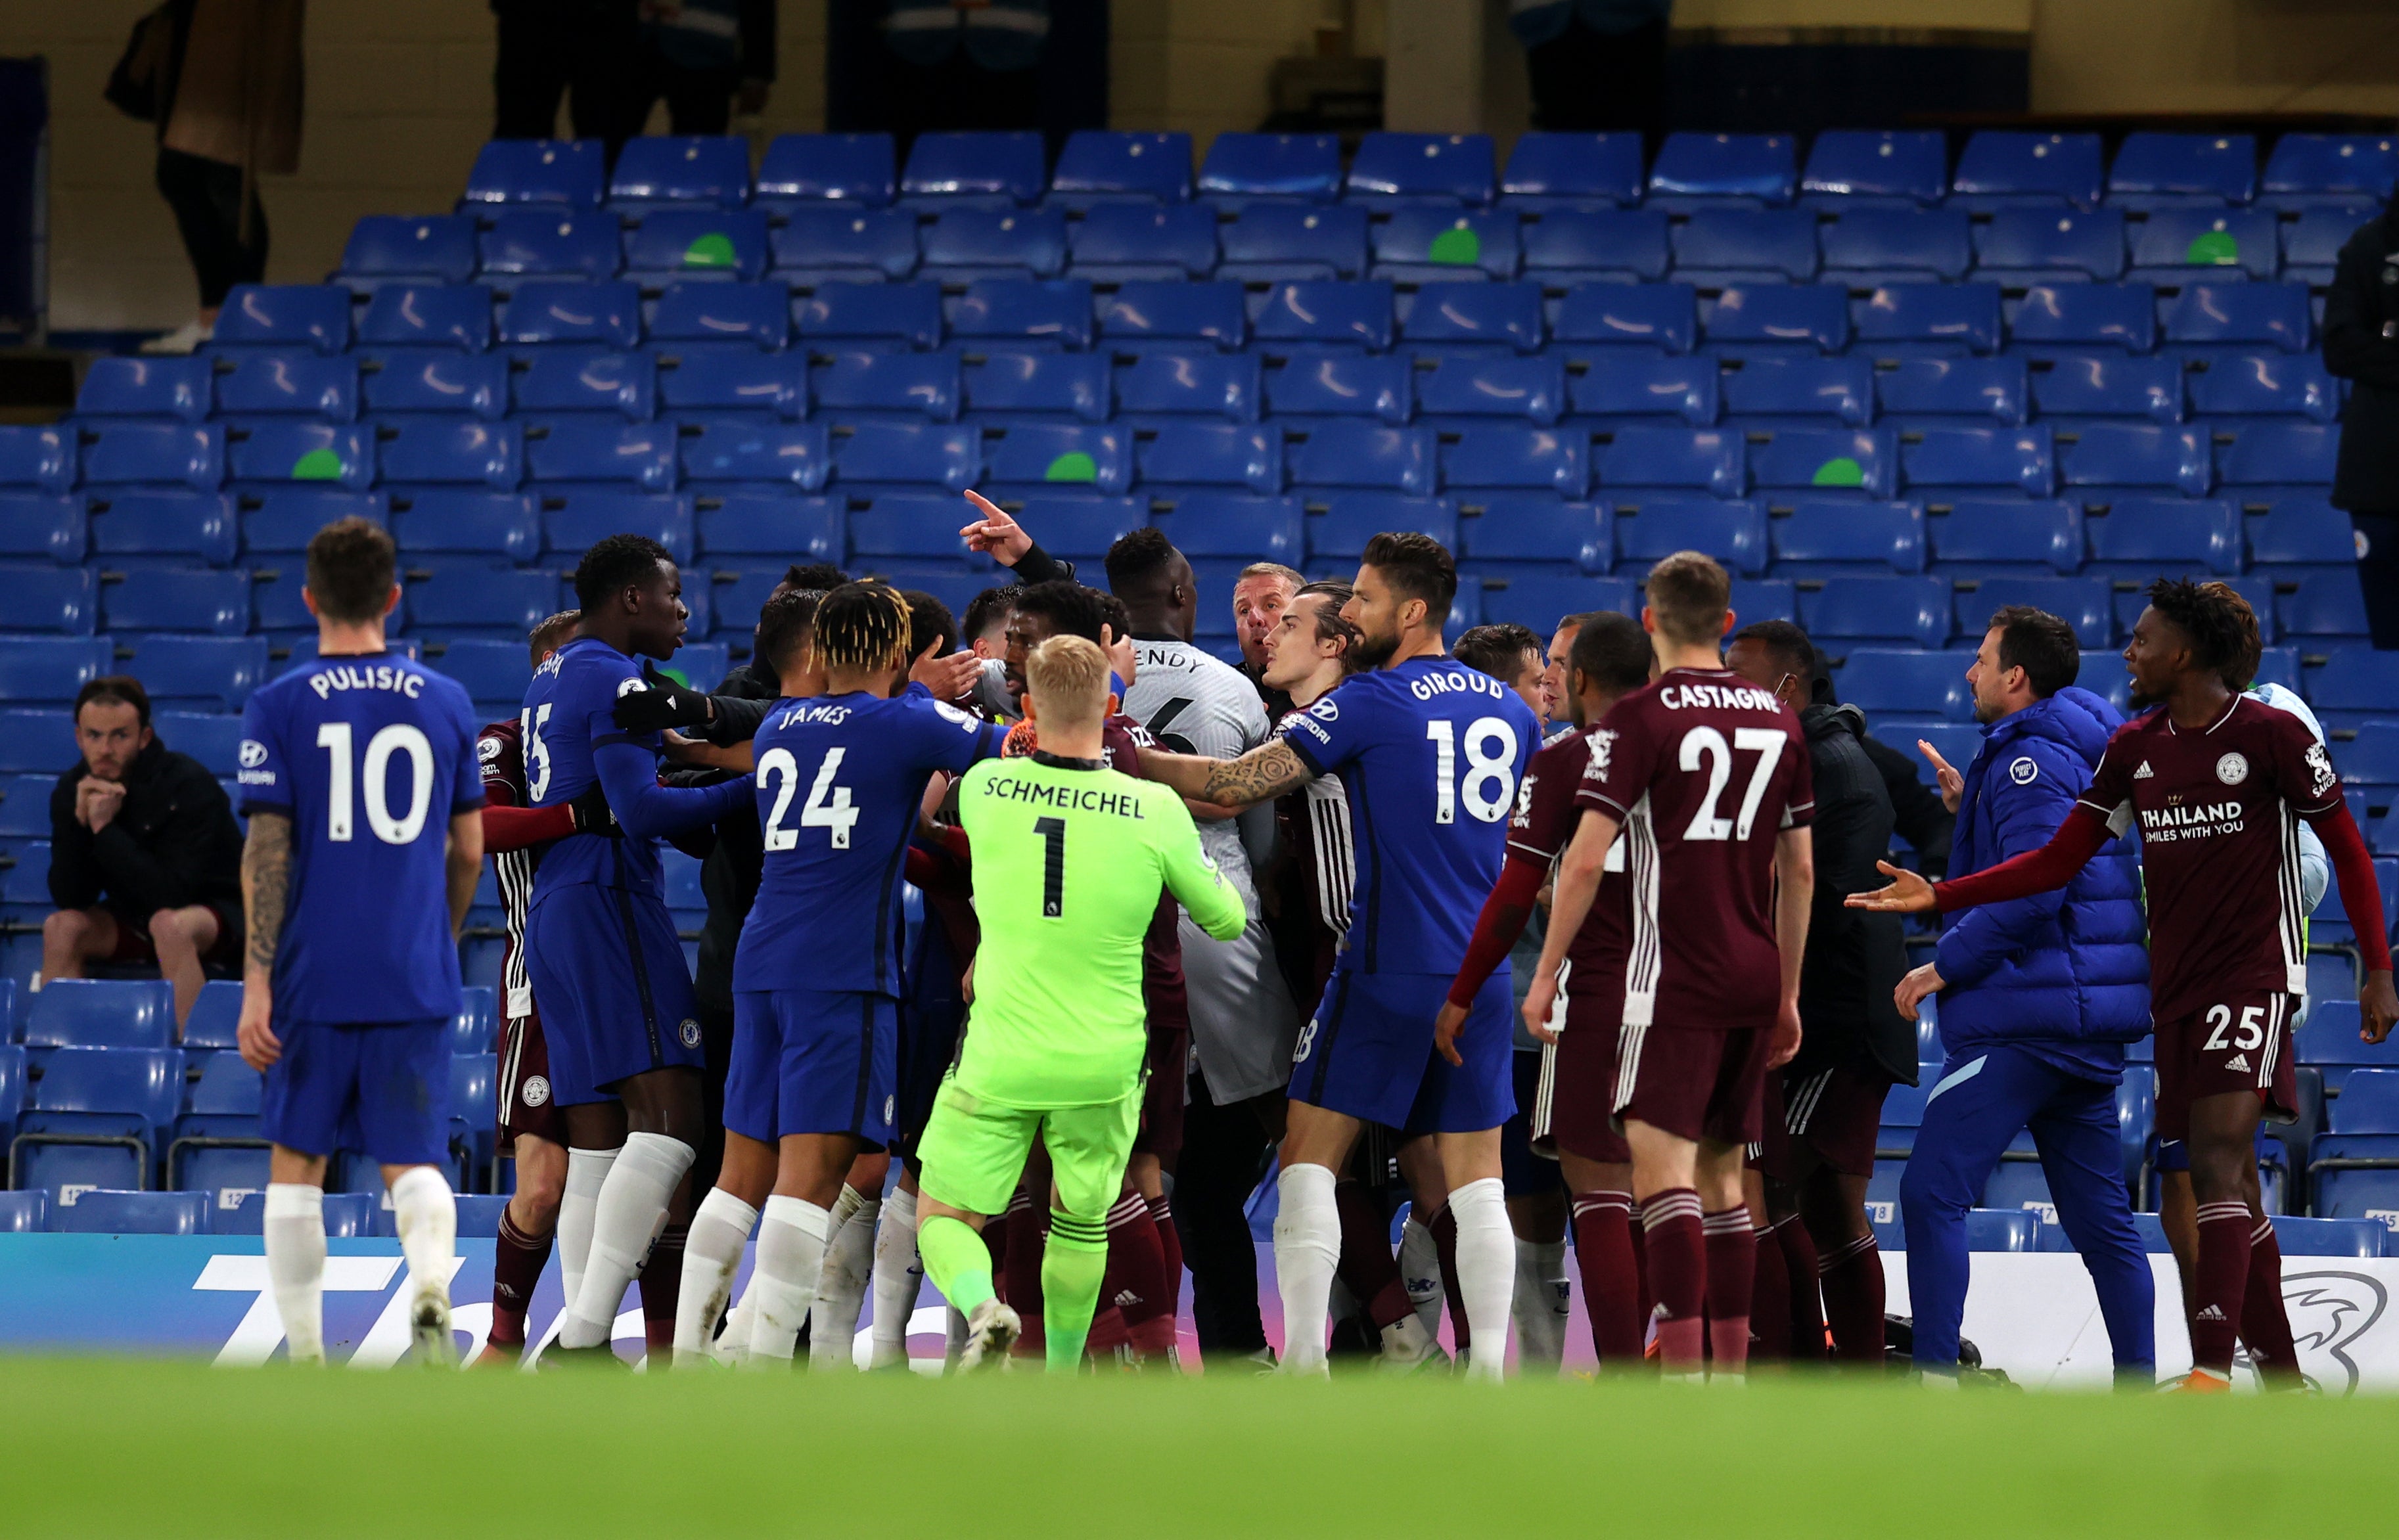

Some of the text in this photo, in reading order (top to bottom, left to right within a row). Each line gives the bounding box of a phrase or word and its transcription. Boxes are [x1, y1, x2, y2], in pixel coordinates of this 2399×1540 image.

[1135, 649, 1205, 673] ENDY
[309, 666, 425, 700] PULISIC
[1411, 672, 1503, 700] GIROUD
[1660, 685, 1781, 714] CASTAGNE
[779, 706, 852, 731] JAMES
[316, 722, 434, 845] 10
[1427, 717, 1517, 824] 18
[1679, 725, 1787, 841] 27
[757, 747, 860, 851] 24
[984, 777, 1145, 819] SCHMEICHEL
[2141, 802, 2242, 828] THAILAND
[2146, 820, 2243, 843] SMILES WITH YOU
[1033, 816, 1065, 917] 1
[2203, 1004, 2265, 1051] 25
[2225, 1064, 2251, 1074] adidas
